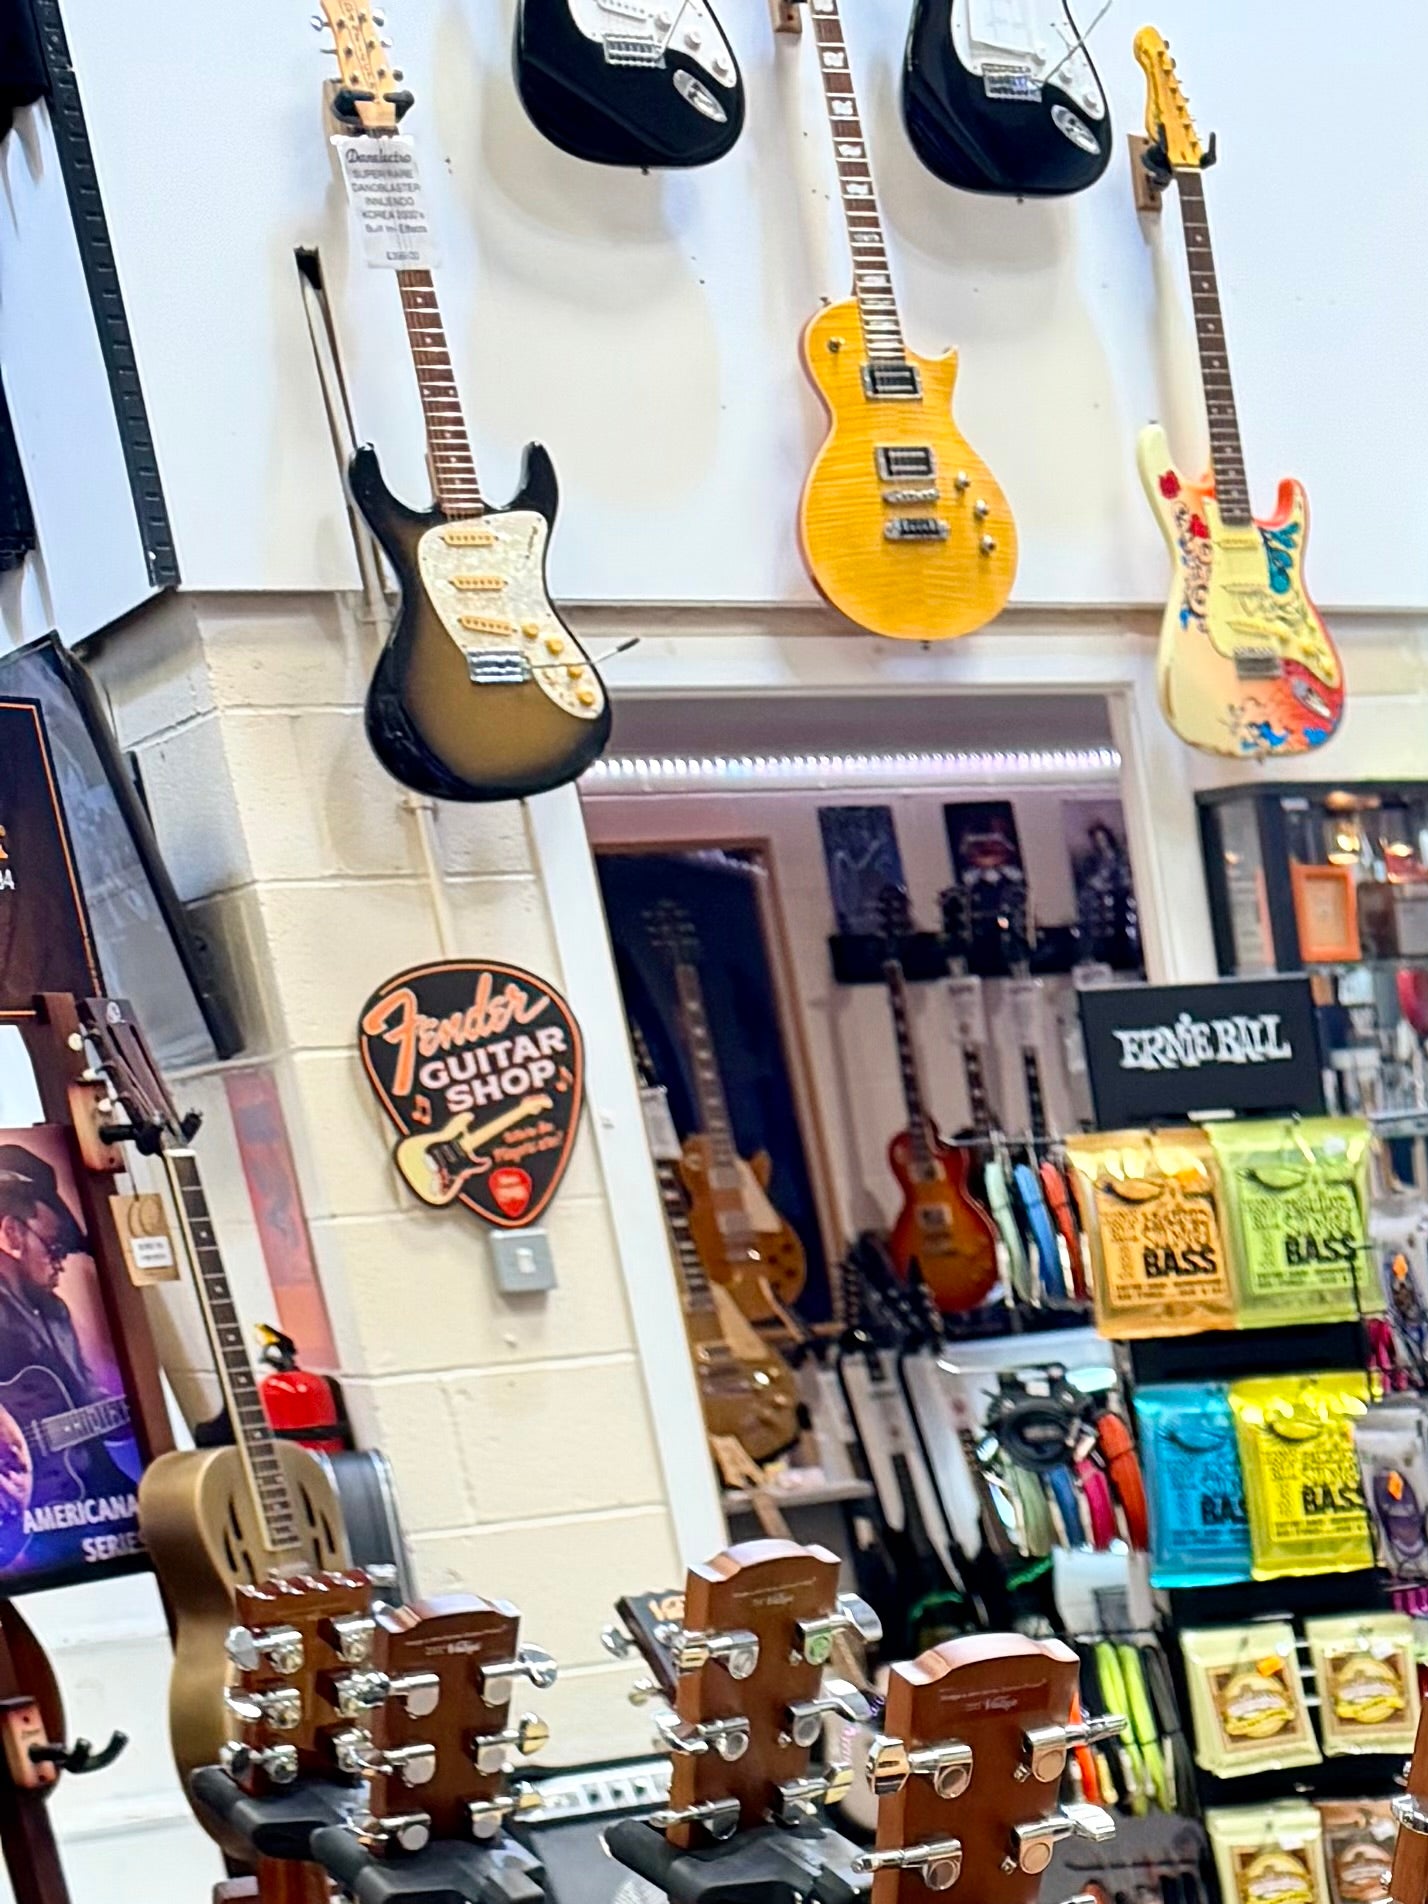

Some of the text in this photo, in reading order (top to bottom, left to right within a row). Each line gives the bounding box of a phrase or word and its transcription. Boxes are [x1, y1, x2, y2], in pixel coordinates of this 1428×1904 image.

[363, 972, 550, 1096] Fender
[419, 1026, 568, 1089] GUITAR
[1112, 1012, 1293, 1071] ERNIE BALL
[445, 1060, 556, 1112] SHOP
[1142, 1246, 1218, 1280] BASS
[1283, 1232, 1357, 1267] BASS
[23, 1493, 140, 1534] AMERICANA
